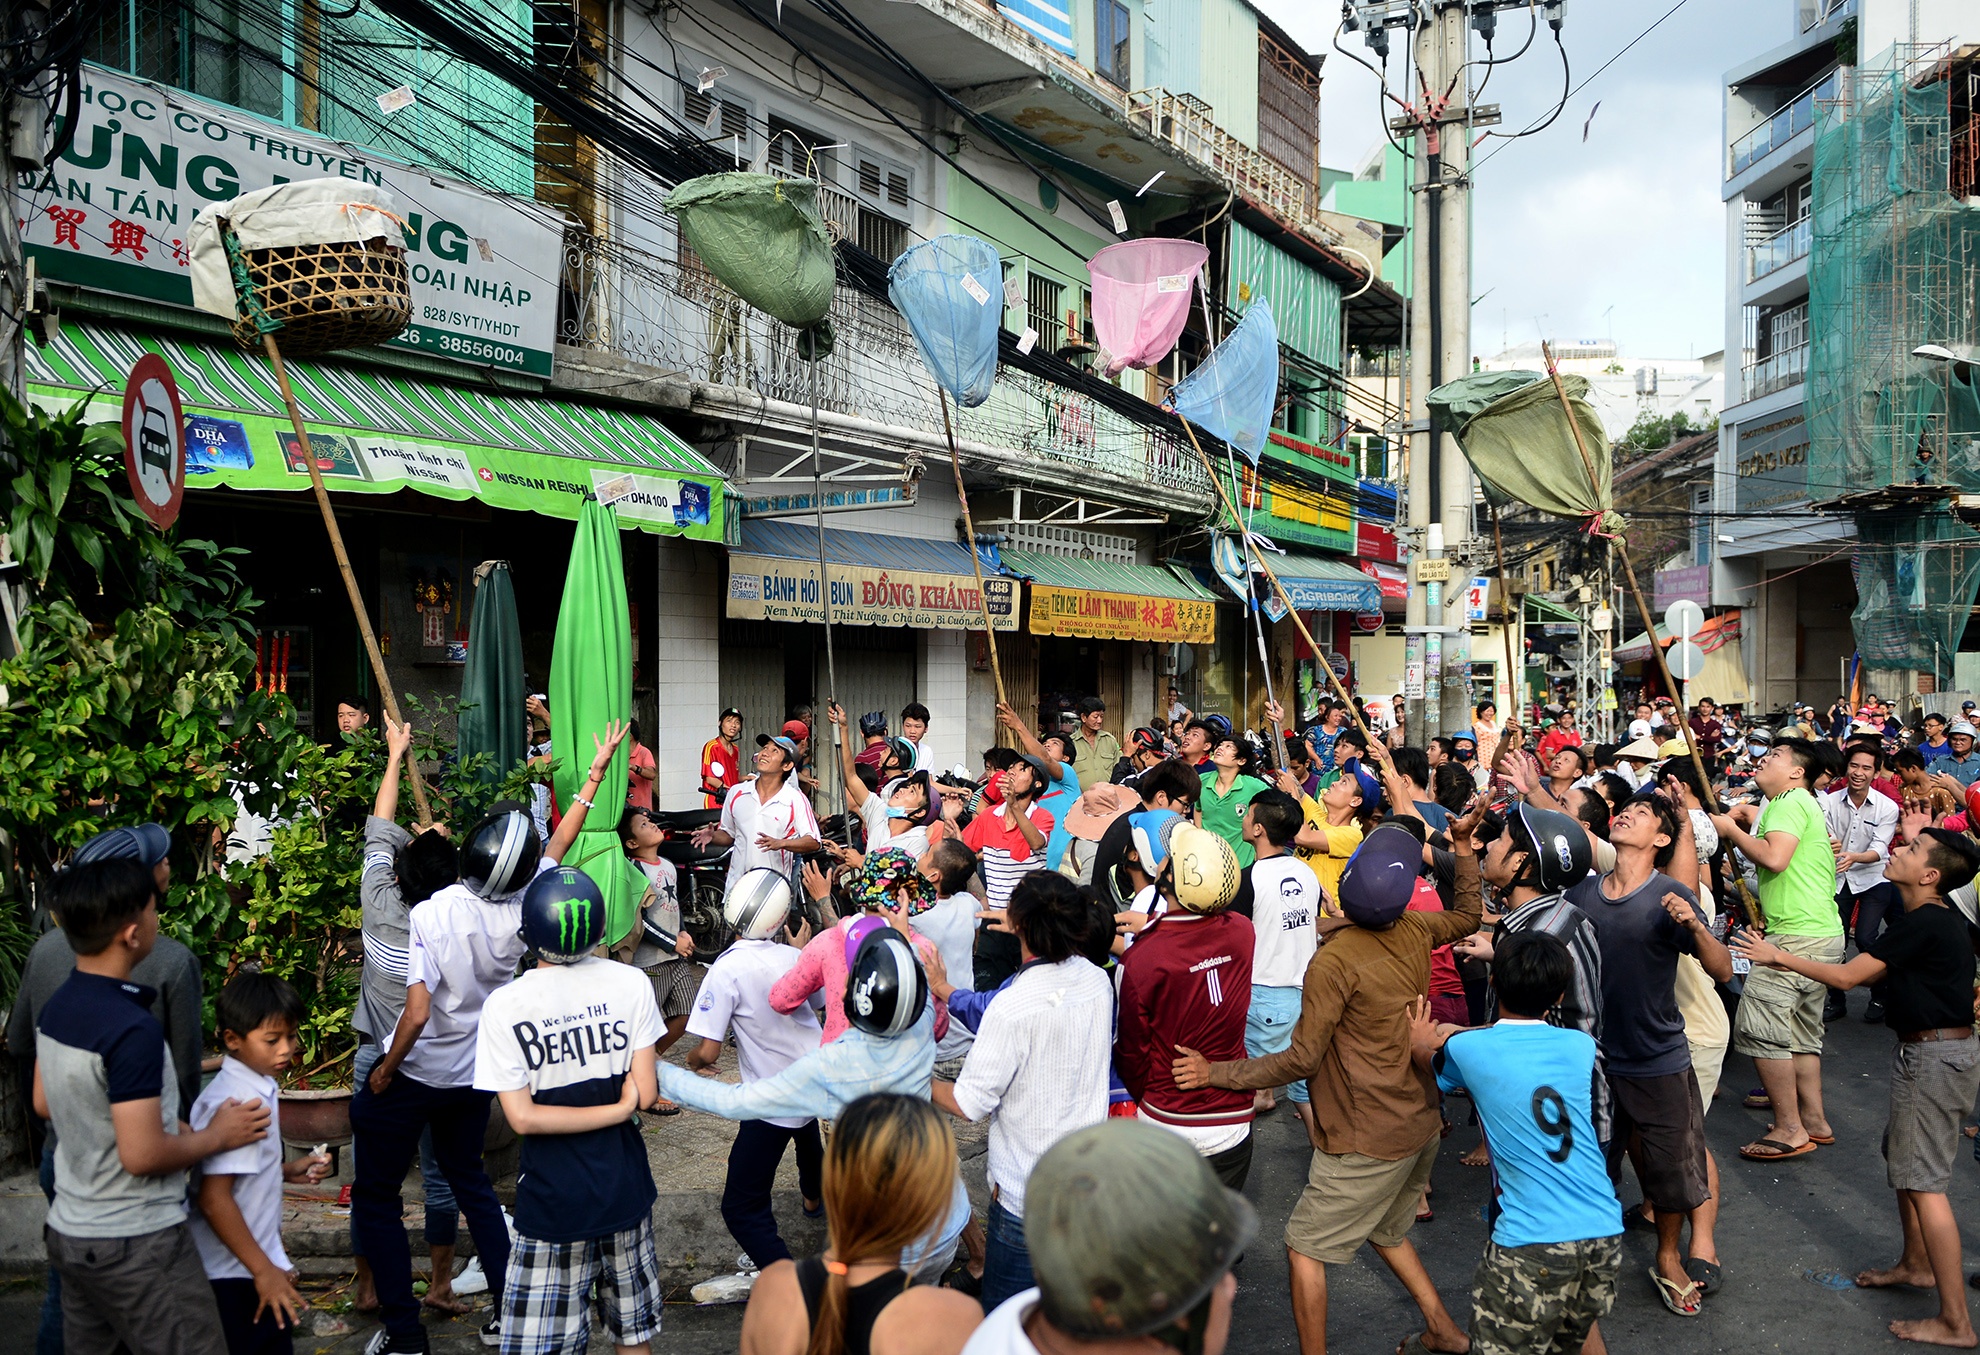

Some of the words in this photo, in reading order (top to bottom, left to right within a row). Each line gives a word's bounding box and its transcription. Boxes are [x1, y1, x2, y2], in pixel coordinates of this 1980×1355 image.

[106, 186, 178, 225] TÁN
[412, 264, 456, 291] OẠI
[464, 276, 532, 308] NHẬP
[423, 305, 446, 322] 828
[397, 329, 420, 344] 26
[439, 335, 525, 365] 38556004
[194, 428, 227, 443] DHA
[417, 451, 443, 466] linh
[446, 457, 465, 470] chi
[404, 463, 450, 483] Nissan
[495, 471, 546, 491] NISSAN
[548, 479, 590, 496] REISHI
[763, 569, 797, 602] BÁNH
[800, 569, 819, 604] HỎI
[831, 575, 854, 606] BÚN
[862, 572, 915, 608] ĐỒNG
[920, 580, 981, 611] KHÁNH
[987, 582, 1009, 594] 488
[1291, 588, 1360, 602] AGRIBANK
[1079, 591, 1101, 617] LÂM
[763, 605, 788, 617] Nem
[833, 610, 854, 624] Thịt
[856, 610, 890, 625] Nướng,
[892, 612, 913, 623] Chả
[936, 615, 946, 624] Bì
[992, 615, 1013, 627] Cuốn
[1084, 620, 1093, 628] CÓ
[1108, 621, 1130, 630] NHÁNH
[1282, 914, 1311, 931] STYLE
[1198, 956, 1223, 970] adidas
[542, 1015, 560, 1029] We
[563, 1012, 585, 1024] love
[587, 1002, 610, 1018] THE
[512, 1020, 629, 1071] BEATLES
[1531, 1084, 1574, 1164] 9
